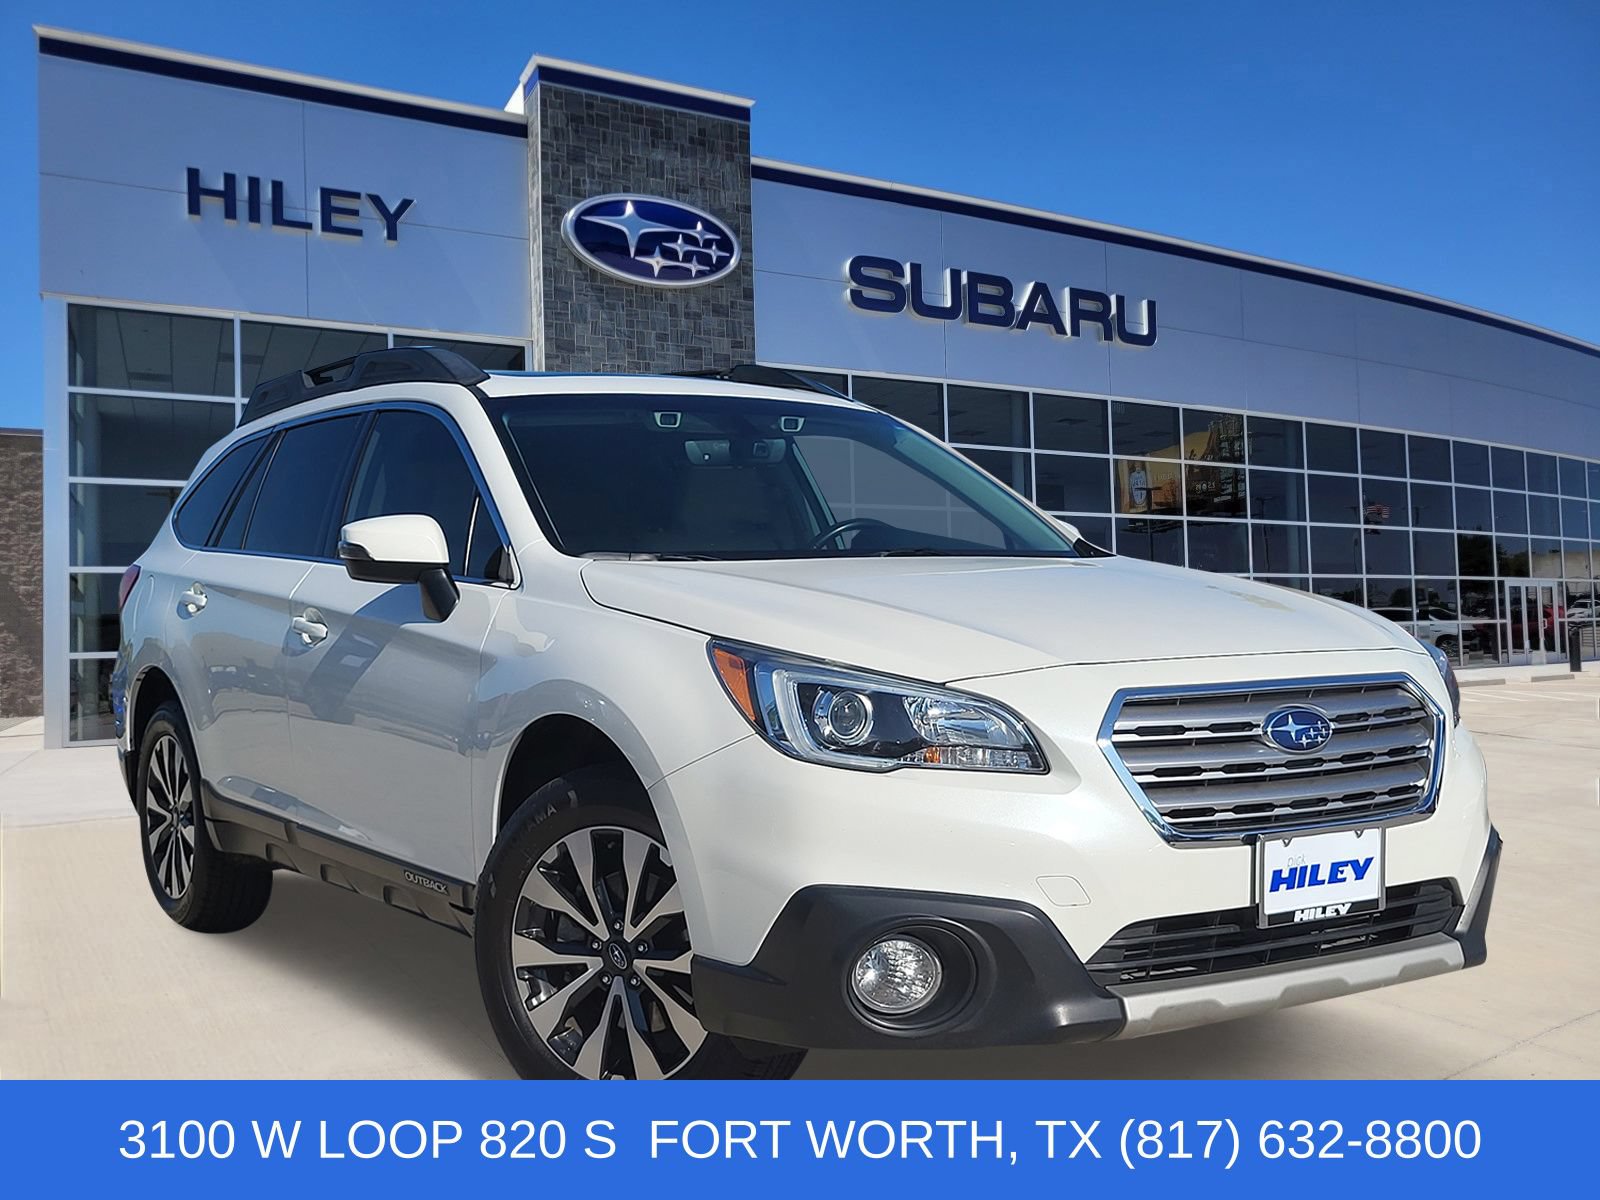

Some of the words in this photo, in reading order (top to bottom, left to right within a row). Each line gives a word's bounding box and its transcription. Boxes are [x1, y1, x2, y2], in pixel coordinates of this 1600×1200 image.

[186, 166, 416, 242] HILEY
[847, 254, 1158, 347] SUBARU
[404, 871, 448, 895] OUTBACK
[1270, 857, 1374, 892] HILEY
[1294, 903, 1351, 922] HILEY
